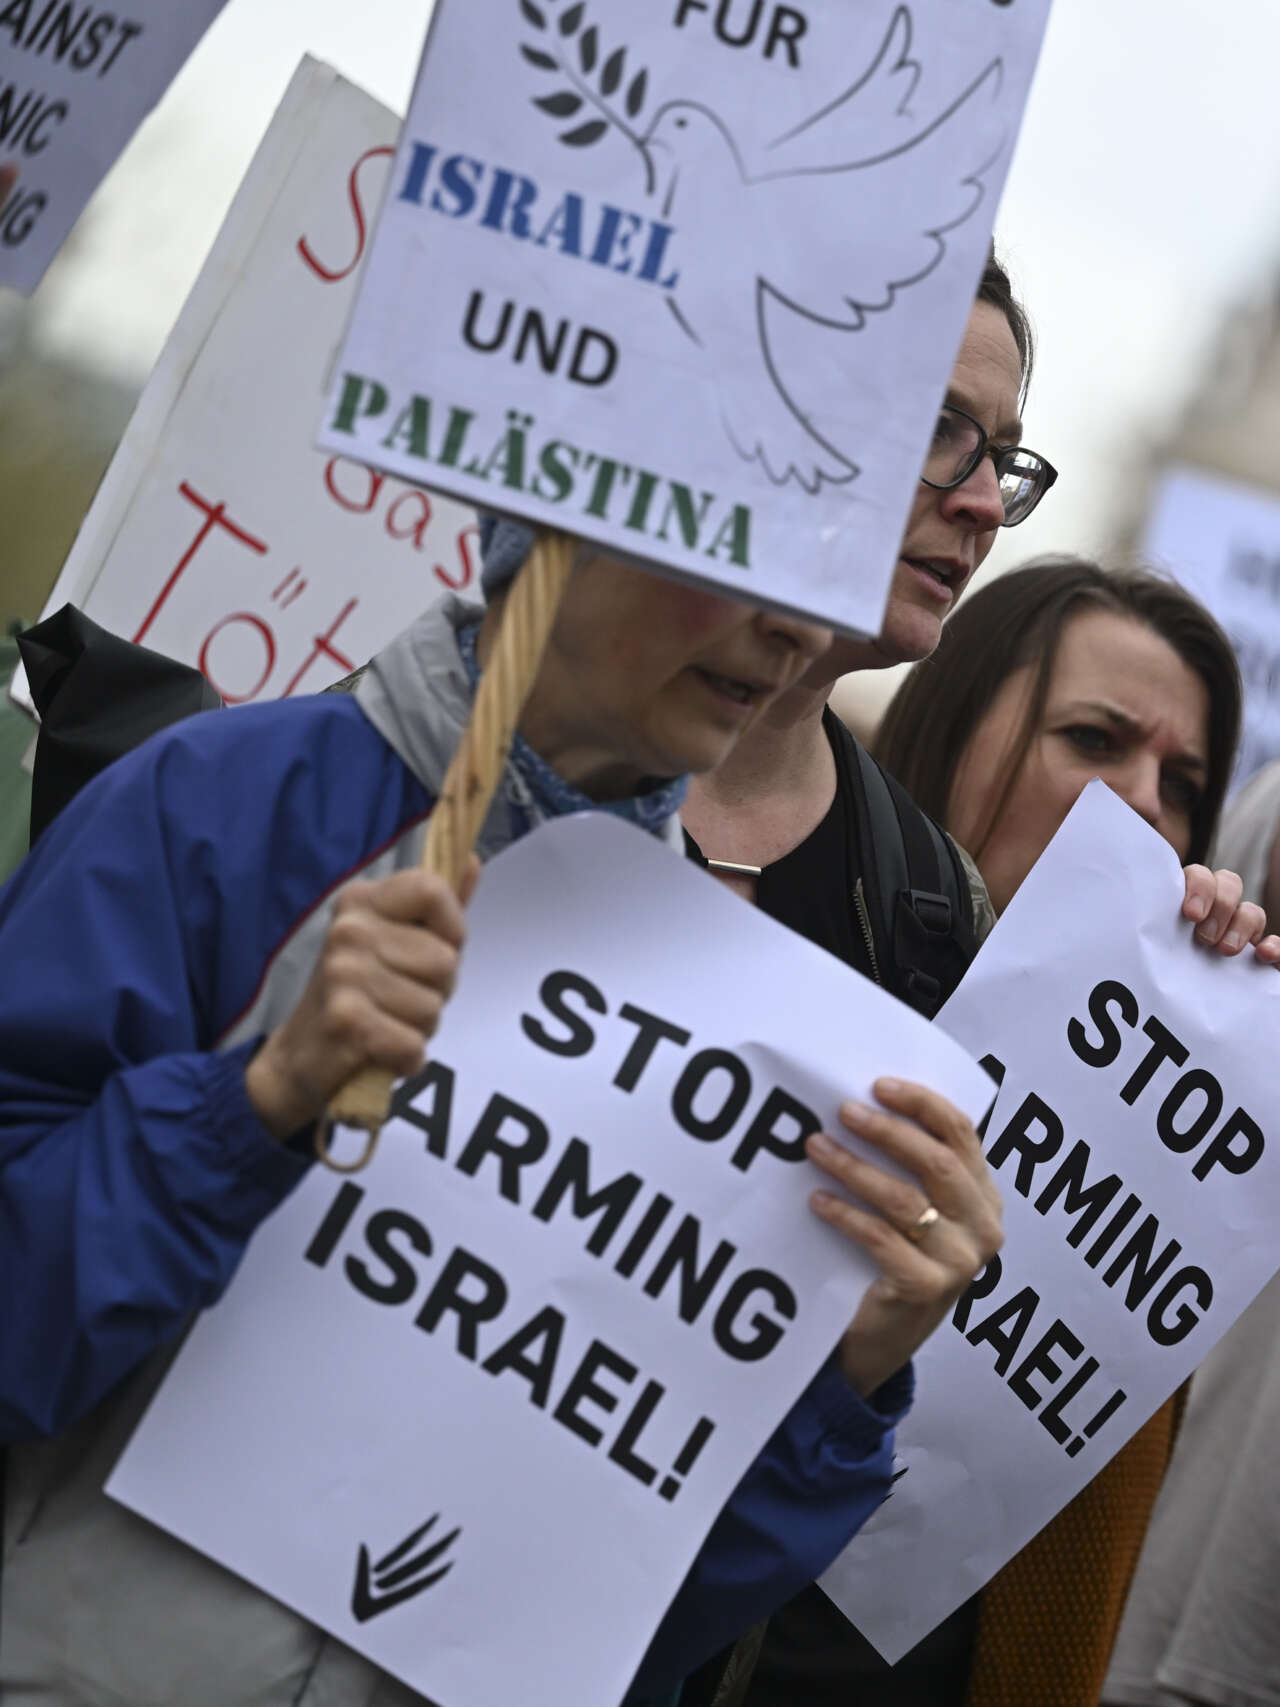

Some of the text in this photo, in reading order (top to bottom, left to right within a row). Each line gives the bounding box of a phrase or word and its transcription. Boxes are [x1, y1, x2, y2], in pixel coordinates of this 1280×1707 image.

[399, 140, 682, 290] ISRAEL
[461, 290, 619, 388] UND
[330, 372, 753, 570] PALÄSTINA
[521, 970, 823, 1174] STOP
[1067, 980, 1265, 1182] STOP
[386, 1059, 798, 1362] ARMING
[303, 1180, 716, 1502] ISRAEL!
[952, 1253, 1128, 1458] RAEL!
